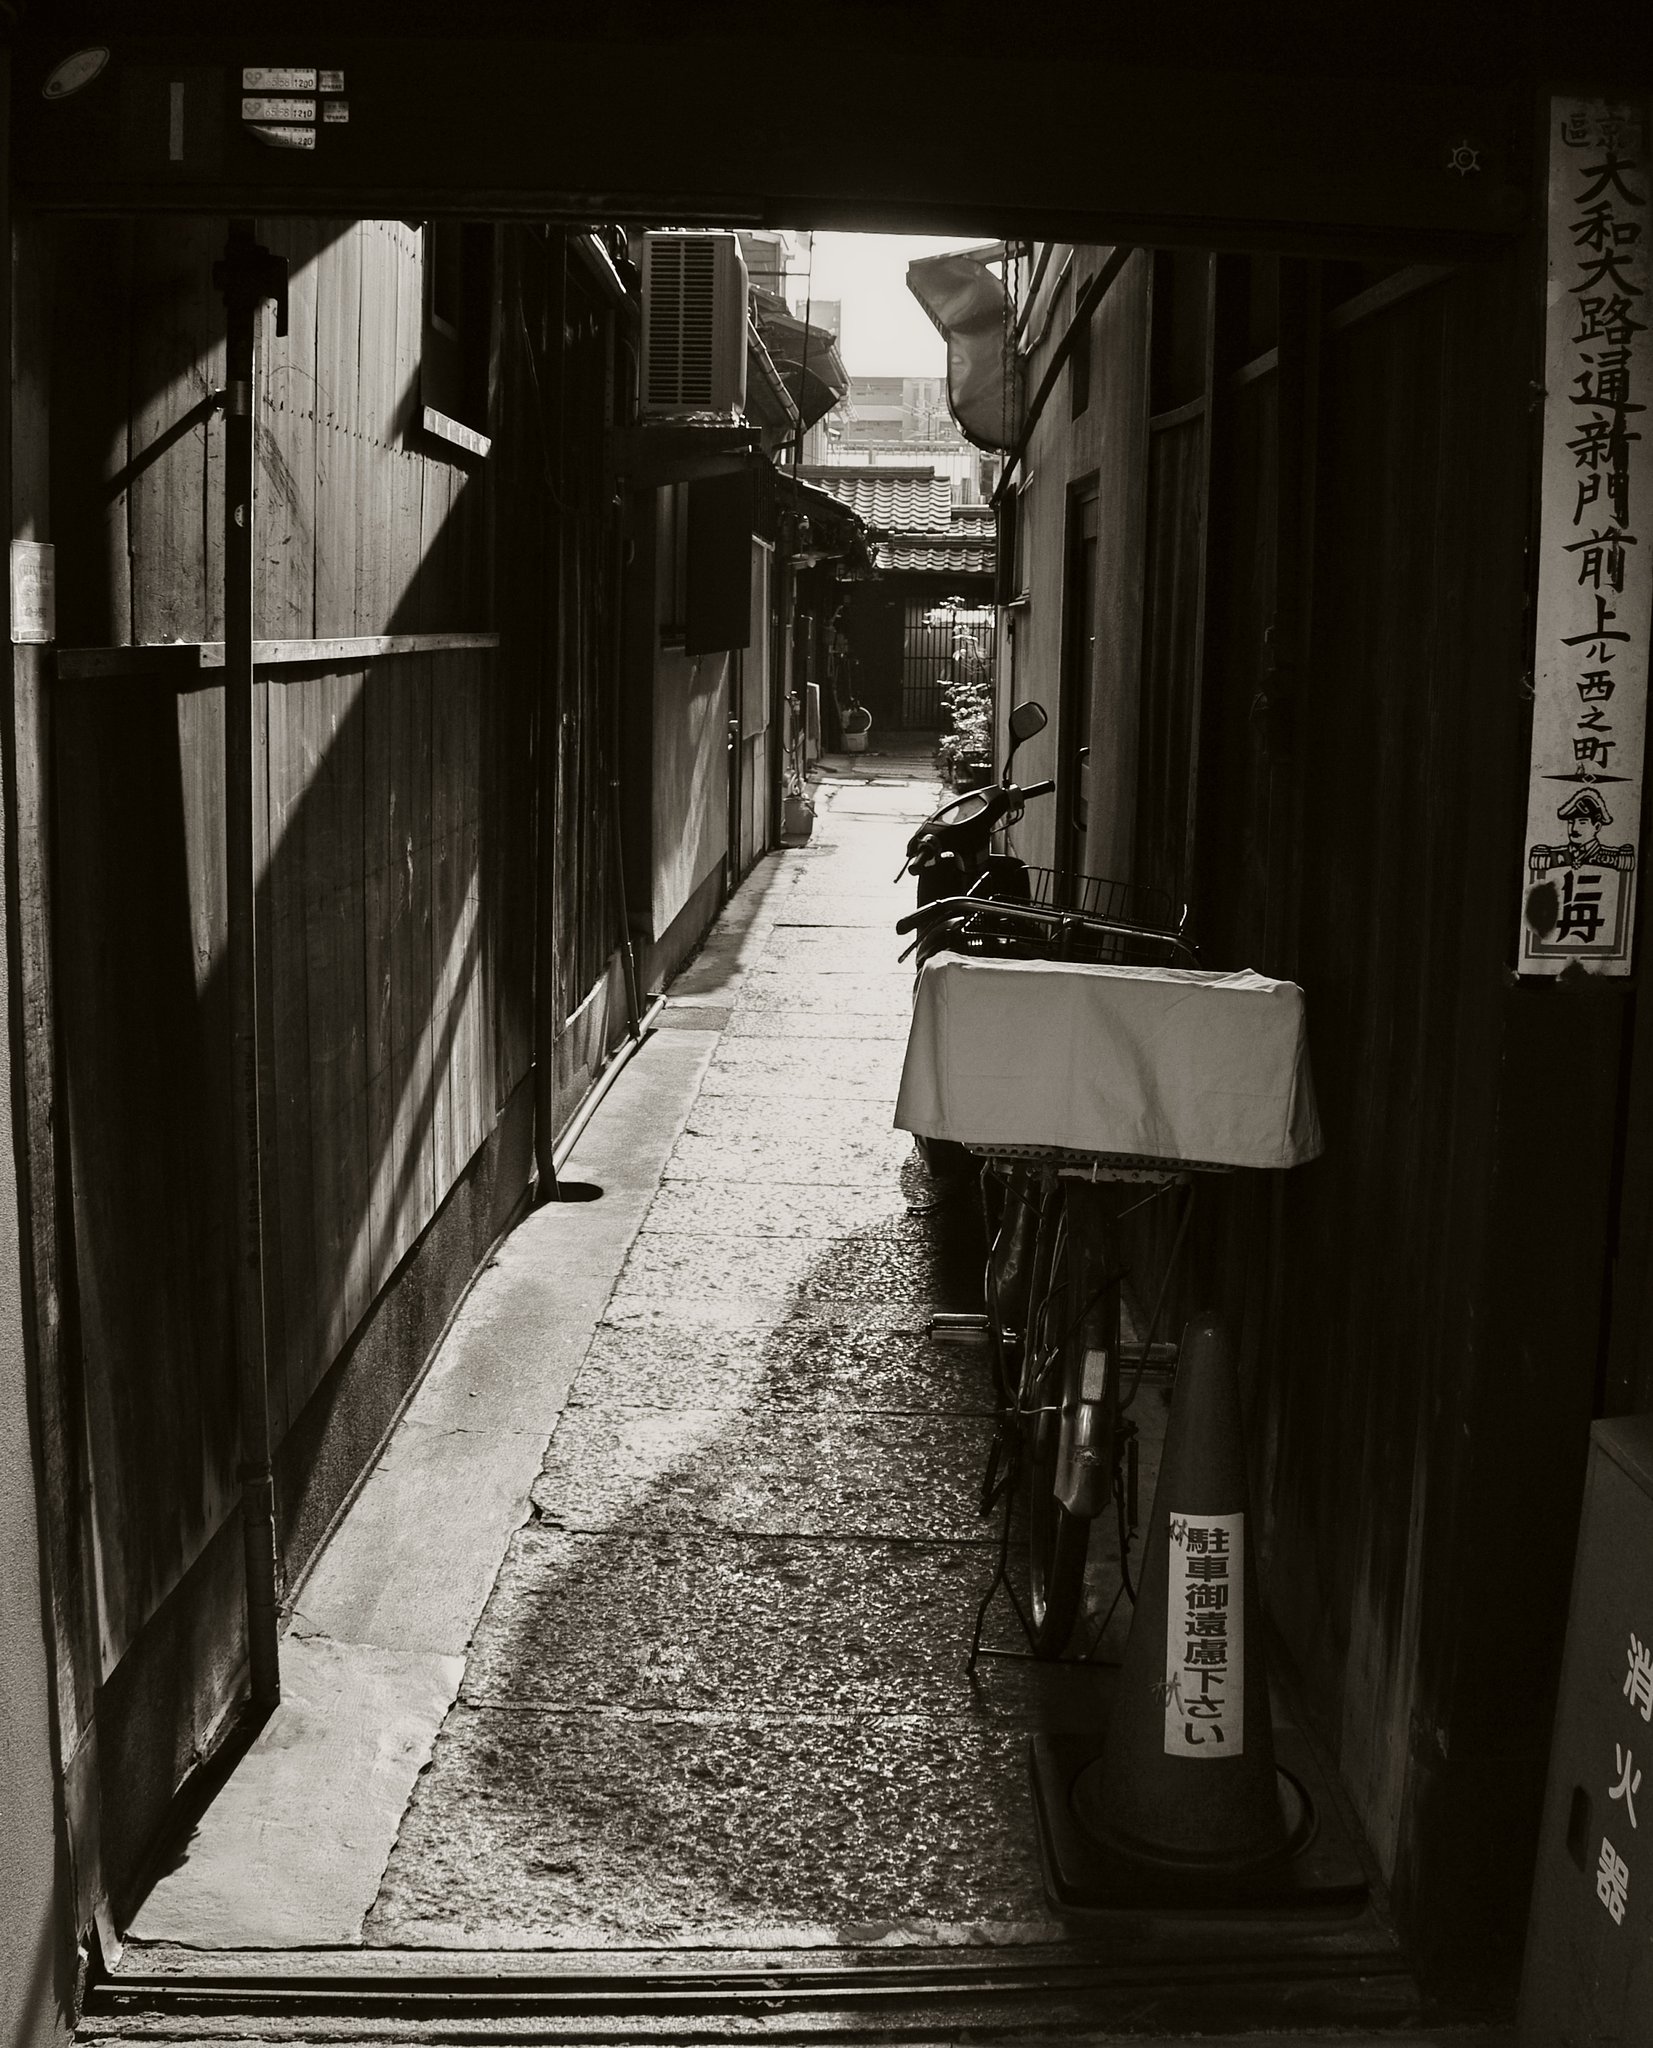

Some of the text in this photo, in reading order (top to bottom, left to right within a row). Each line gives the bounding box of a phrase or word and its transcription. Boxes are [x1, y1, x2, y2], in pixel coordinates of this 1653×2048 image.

[1556, 869, 1605, 943] 仁丹
[1183, 1526, 1231, 1745] 駐車御遠慮下さい
[1597, 1632, 1653, 1926] 消火器
